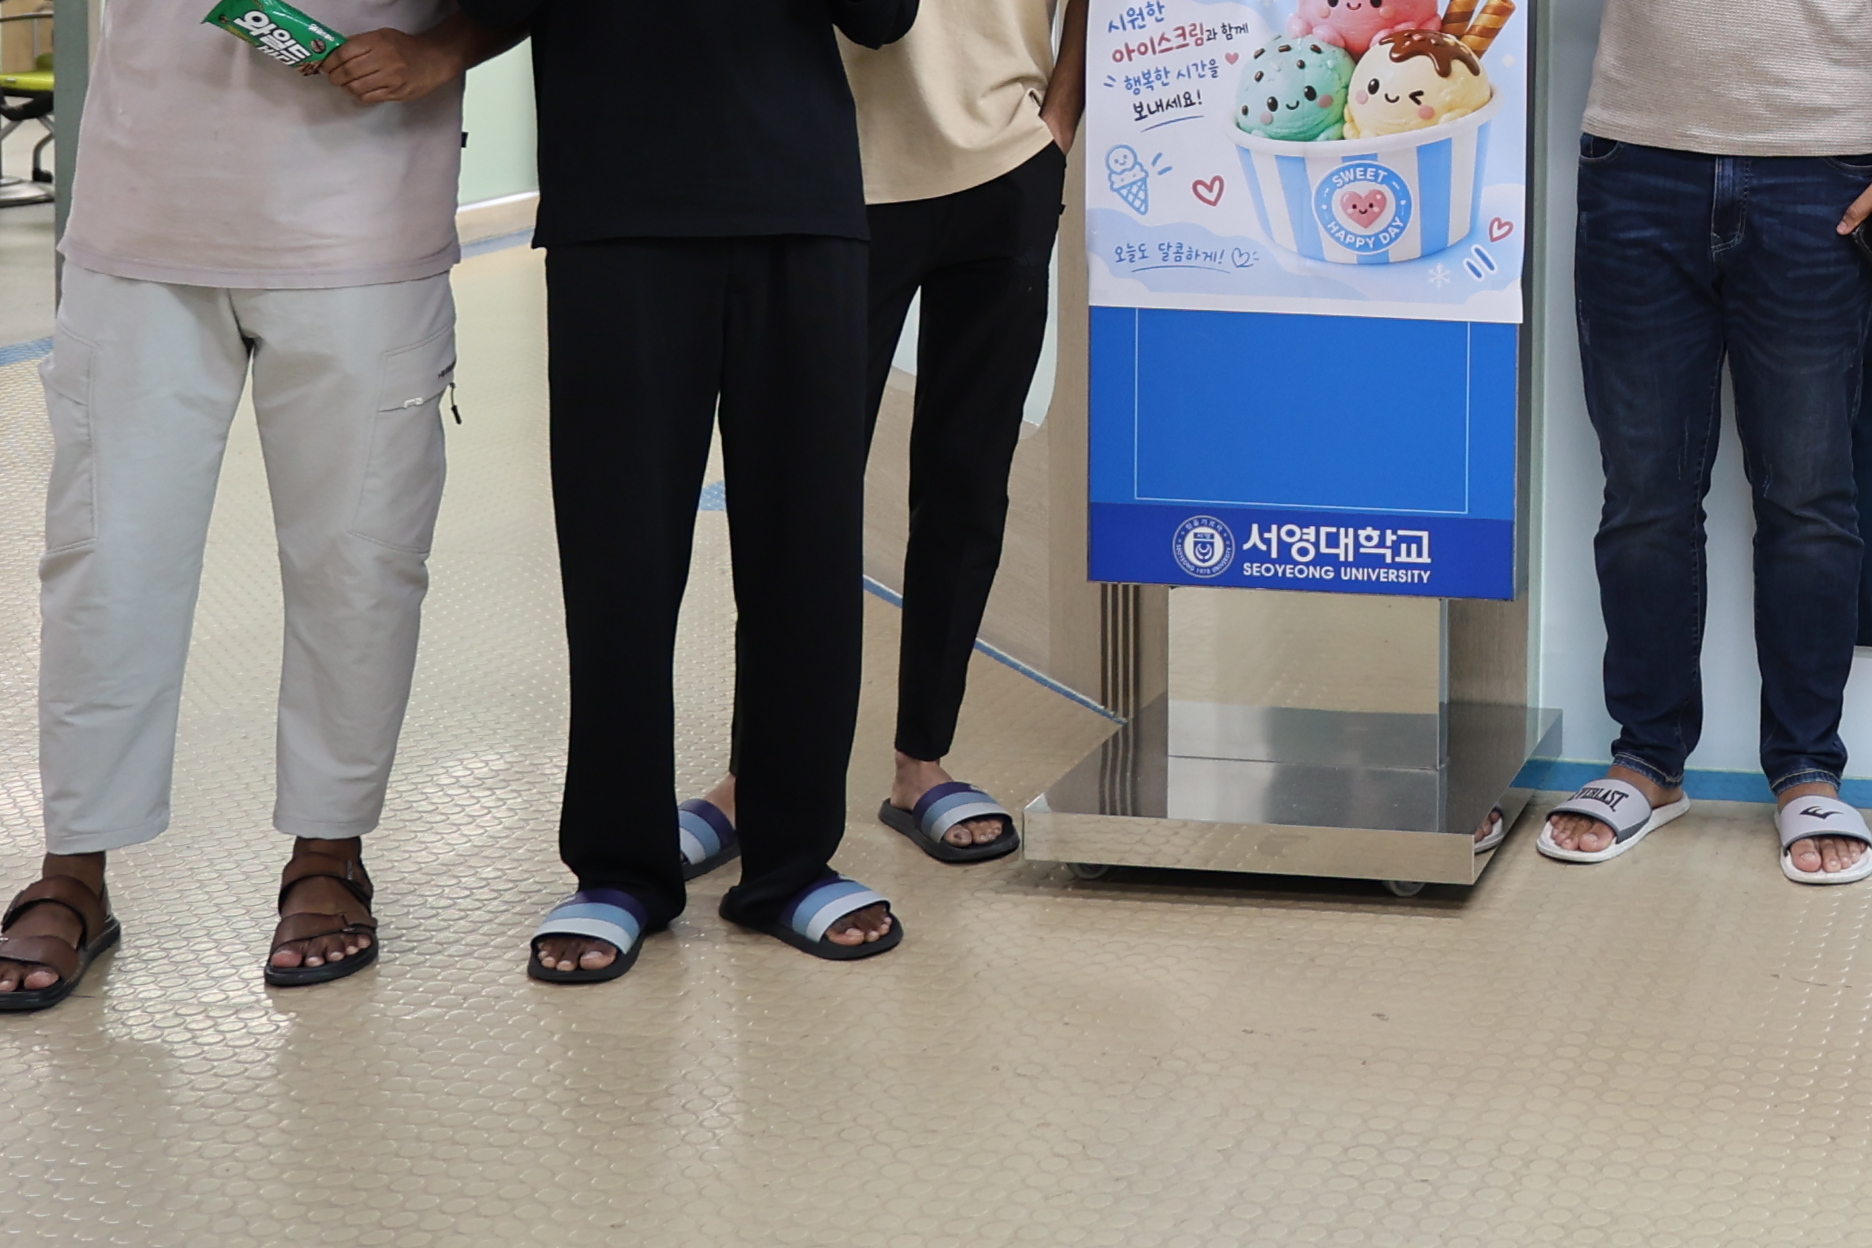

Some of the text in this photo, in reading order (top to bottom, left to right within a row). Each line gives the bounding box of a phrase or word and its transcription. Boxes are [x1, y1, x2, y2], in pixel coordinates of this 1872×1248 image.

[1108, 0, 1165, 33] 시원한
[233, 10, 312, 62] 와일드
[1112, 22, 1249, 63] 아이스크림과 함께
[1124, 58, 1219, 95] 행복한 시간을
[1133, 89, 1203, 121] 보내세요!
[1332, 167, 1388, 187] SWEET
[1327, 216, 1404, 249] HAPPY DAY
[1114, 241, 1225, 264] 오늘도 달콤하게!
[1242, 523, 1432, 563] 서영대학교
[1242, 563, 1431, 584] SEOYEONG UNIVERSITY
